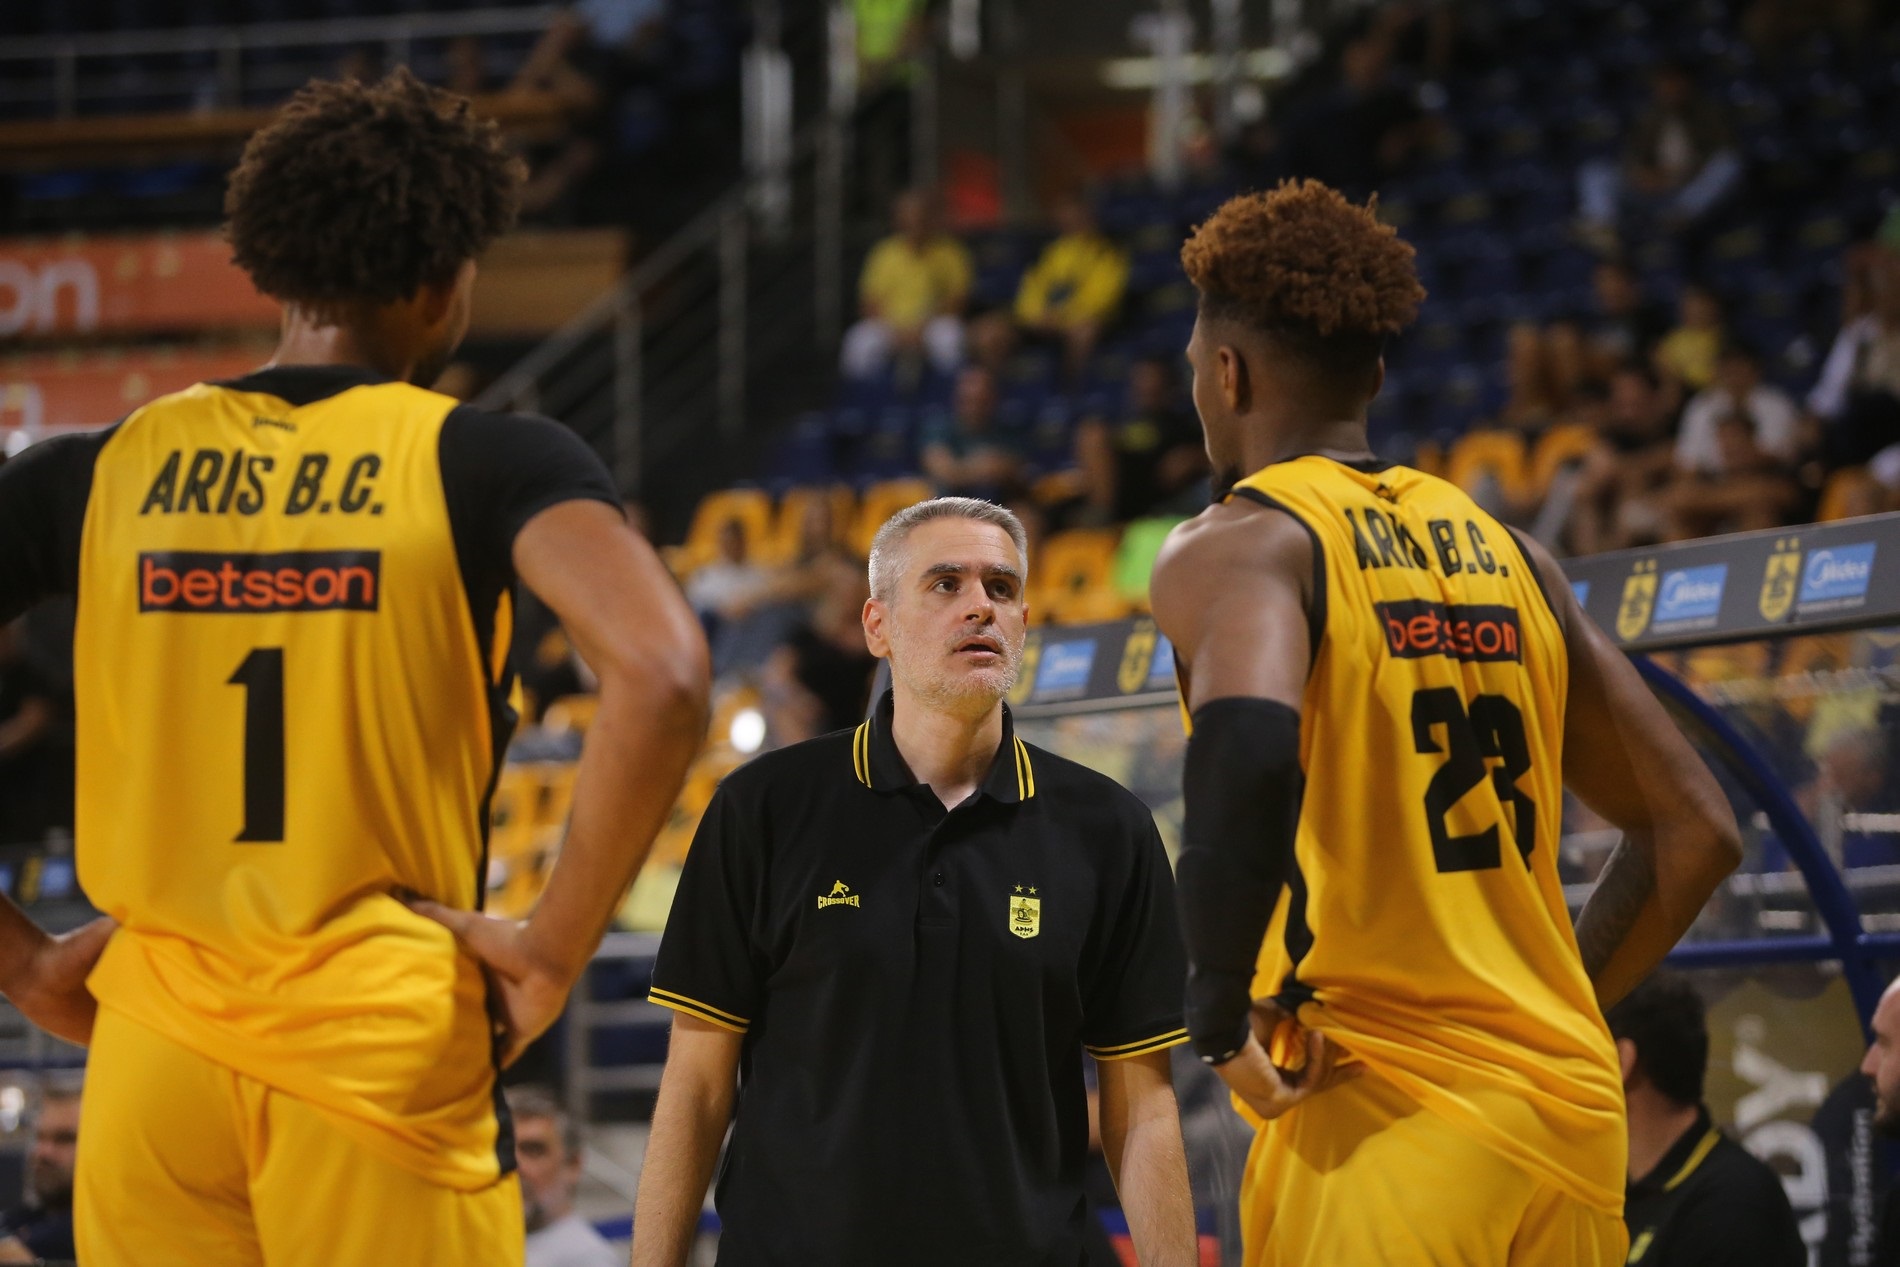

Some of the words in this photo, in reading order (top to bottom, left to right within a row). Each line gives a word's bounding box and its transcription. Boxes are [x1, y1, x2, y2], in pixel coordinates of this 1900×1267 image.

[139, 449, 274, 516] ARIS
[284, 452, 383, 515] B.C.
[1427, 519, 1509, 578] B.C.
[143, 558, 375, 607] betsson
[226, 646, 284, 842] 1
[1411, 686, 1537, 873] 23
[817, 895, 860, 909] CROSSOVER
